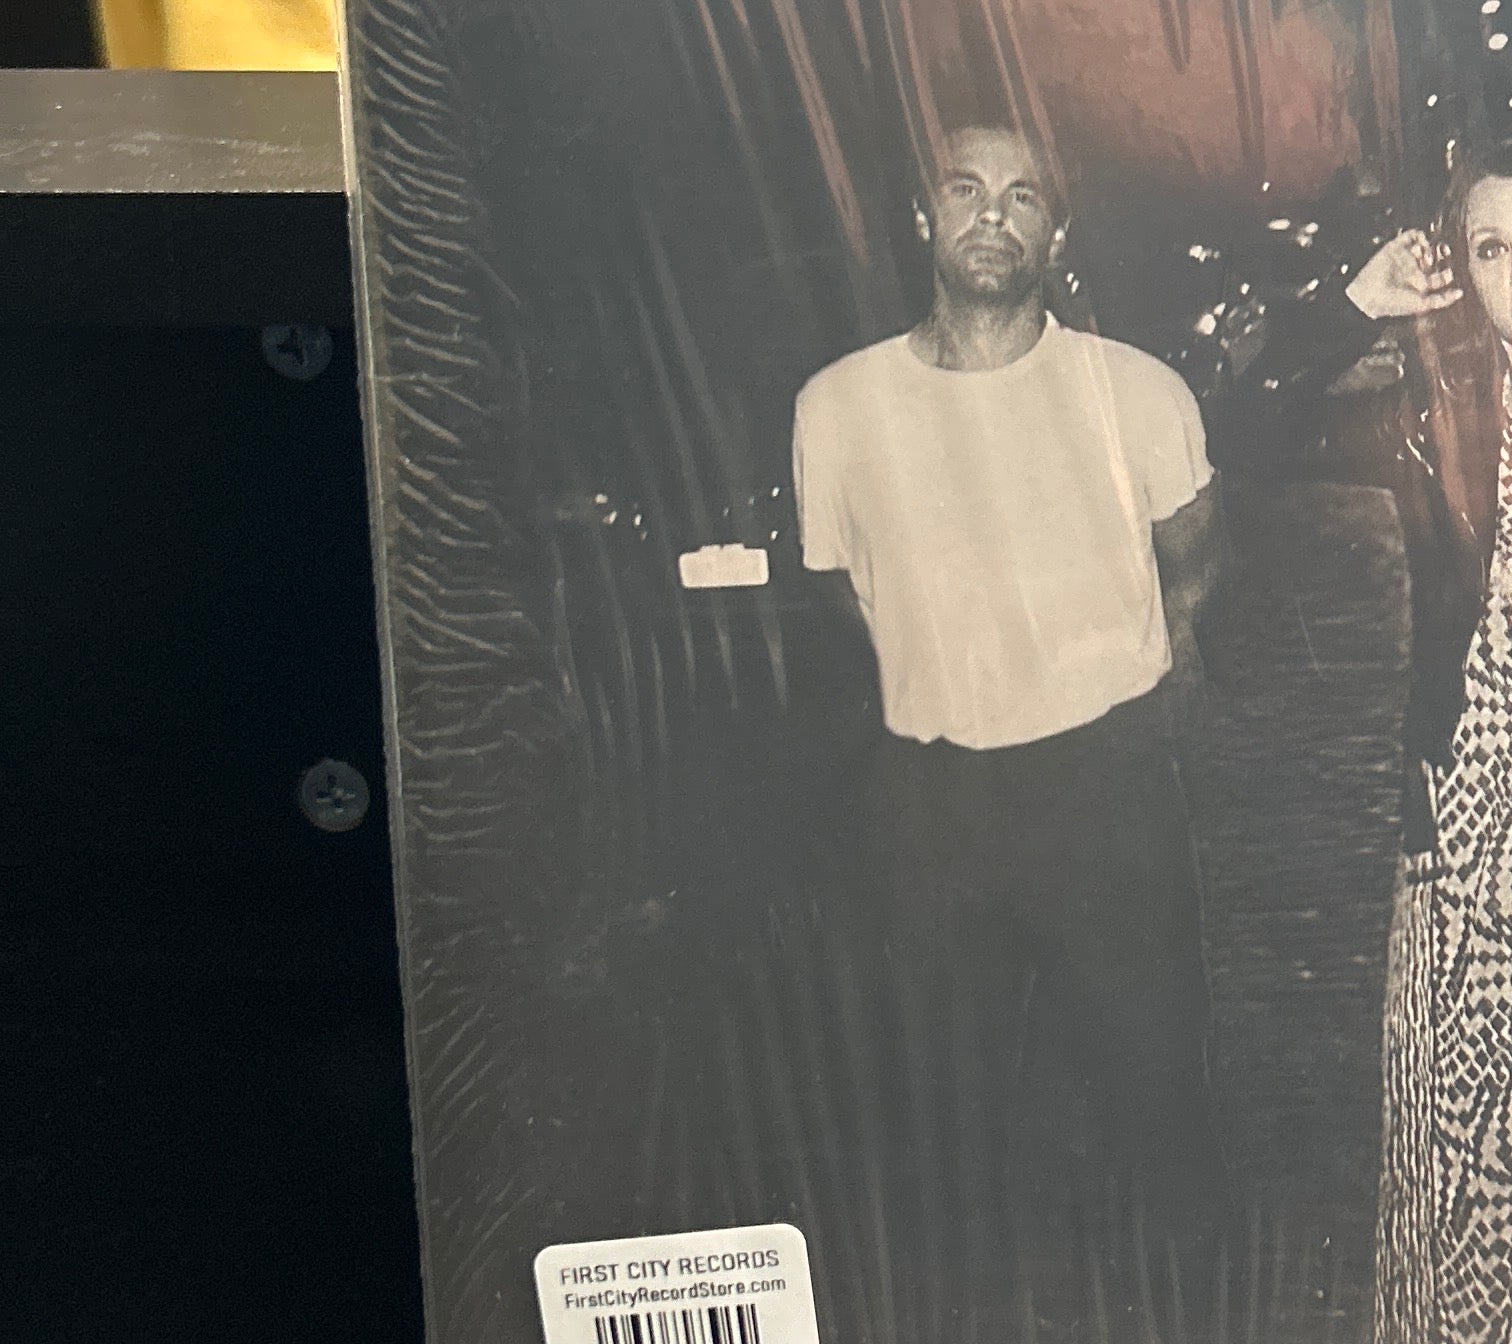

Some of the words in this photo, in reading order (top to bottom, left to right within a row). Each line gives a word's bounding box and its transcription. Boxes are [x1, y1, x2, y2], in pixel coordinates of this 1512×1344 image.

[559, 1264, 620, 1285] FIRST
[627, 1259, 671, 1280] CITY
[678, 1249, 780, 1275] RECORDS
[564, 1277, 787, 1309] FirstCityRecordStore.com
